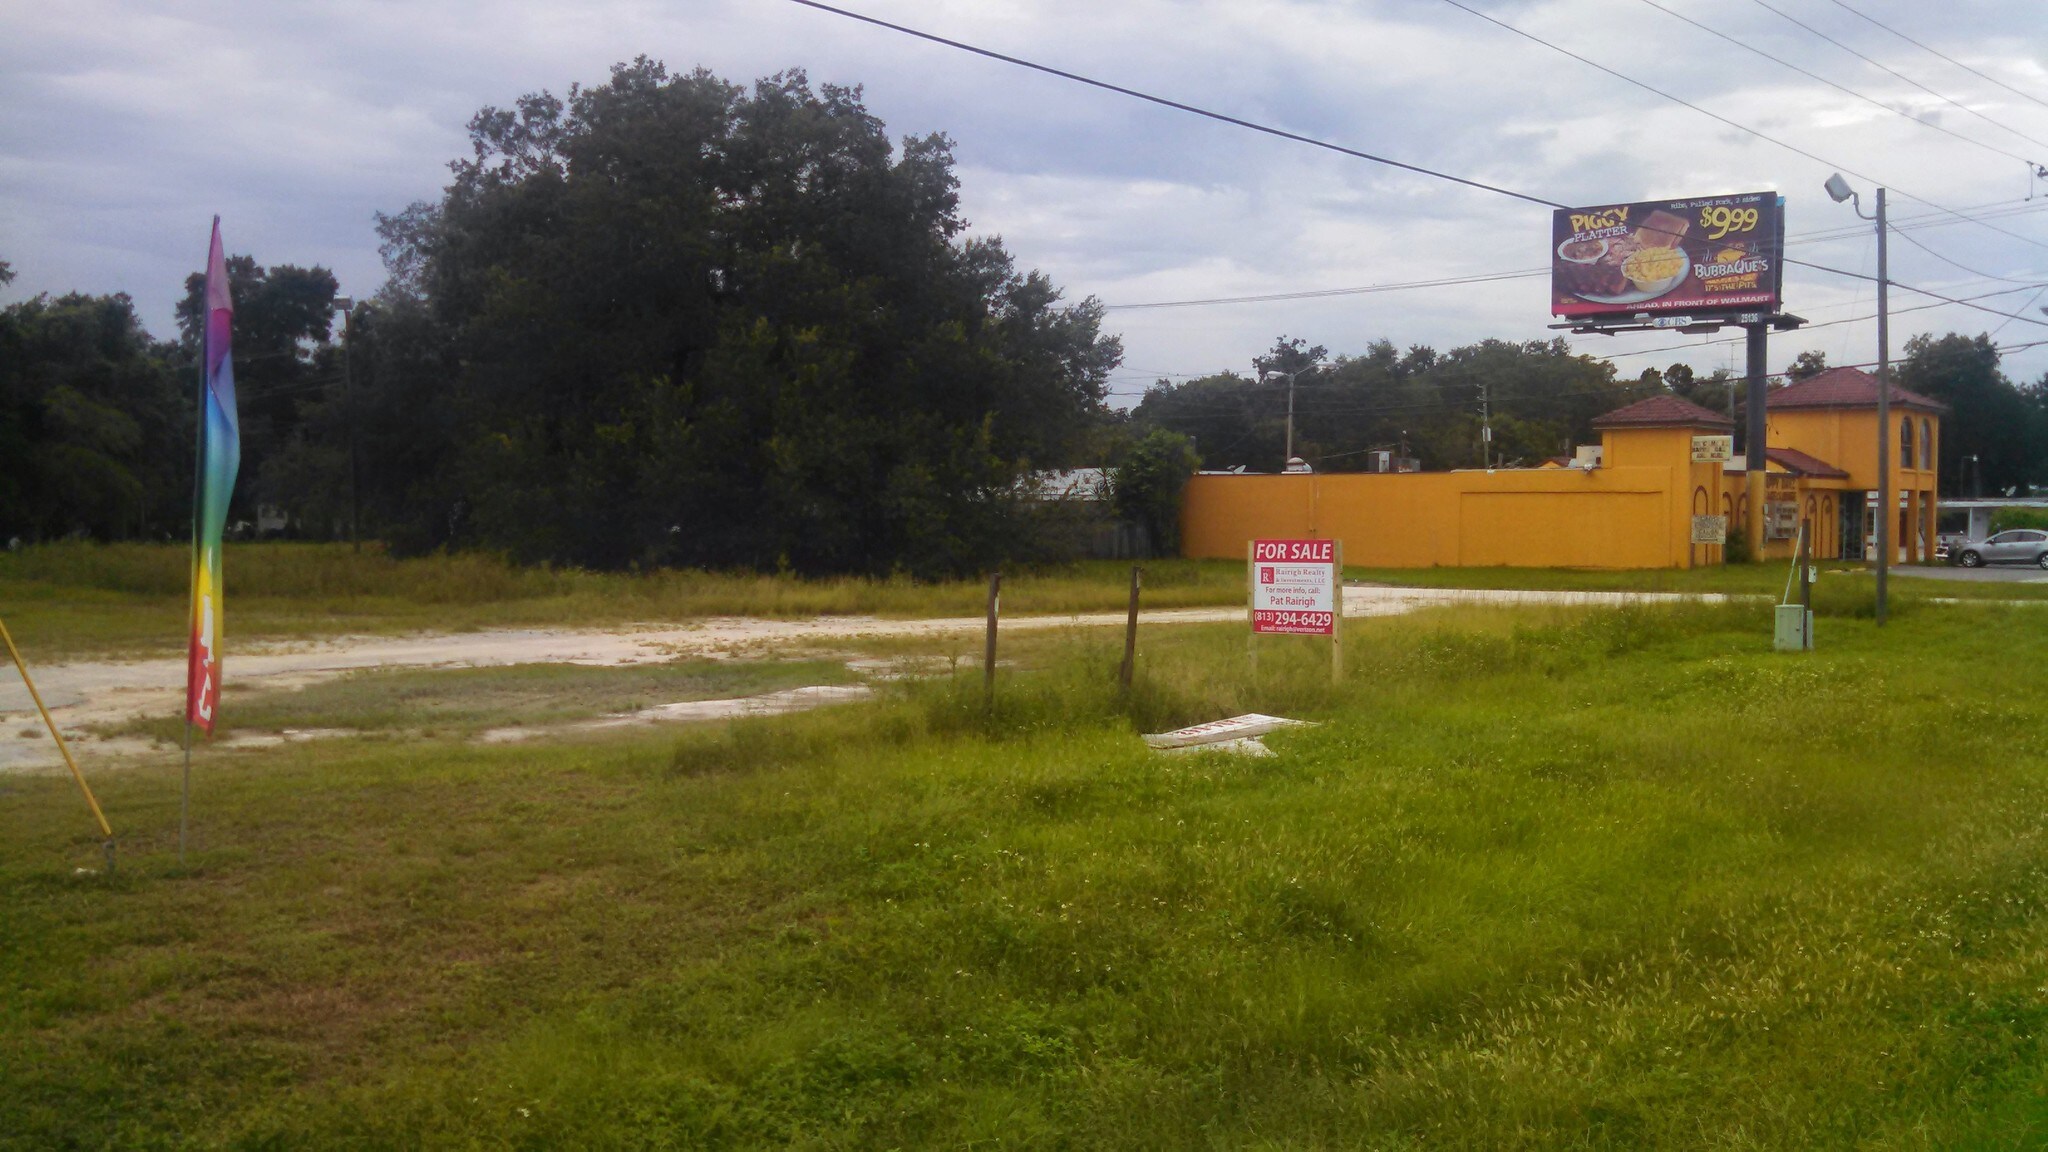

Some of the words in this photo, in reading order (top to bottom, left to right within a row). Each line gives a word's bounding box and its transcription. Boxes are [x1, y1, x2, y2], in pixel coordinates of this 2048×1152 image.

[1690, 200, 1713, 208] Pulled
[1569, 206, 1629, 233] PIGGY
[1573, 225, 1629, 243] PLATTER
[1674, 299, 1703, 307] FRONT
[1720, 295, 1770, 304] WALMART
[1667, 317, 1687, 326] CBS
[1256, 543, 1287, 559] FOR
[1290, 543, 1332, 560] SALE
[1275, 568, 1302, 577] Rairigh
[1303, 569, 1325, 577] Realty
[1293, 586, 1307, 595] info,
[1270, 596, 1284, 606] Pat
[1285, 596, 1316, 608] Rairigh
[1254, 611, 1274, 622] (813)
[1274, 612, 1332, 627] 294-6429
